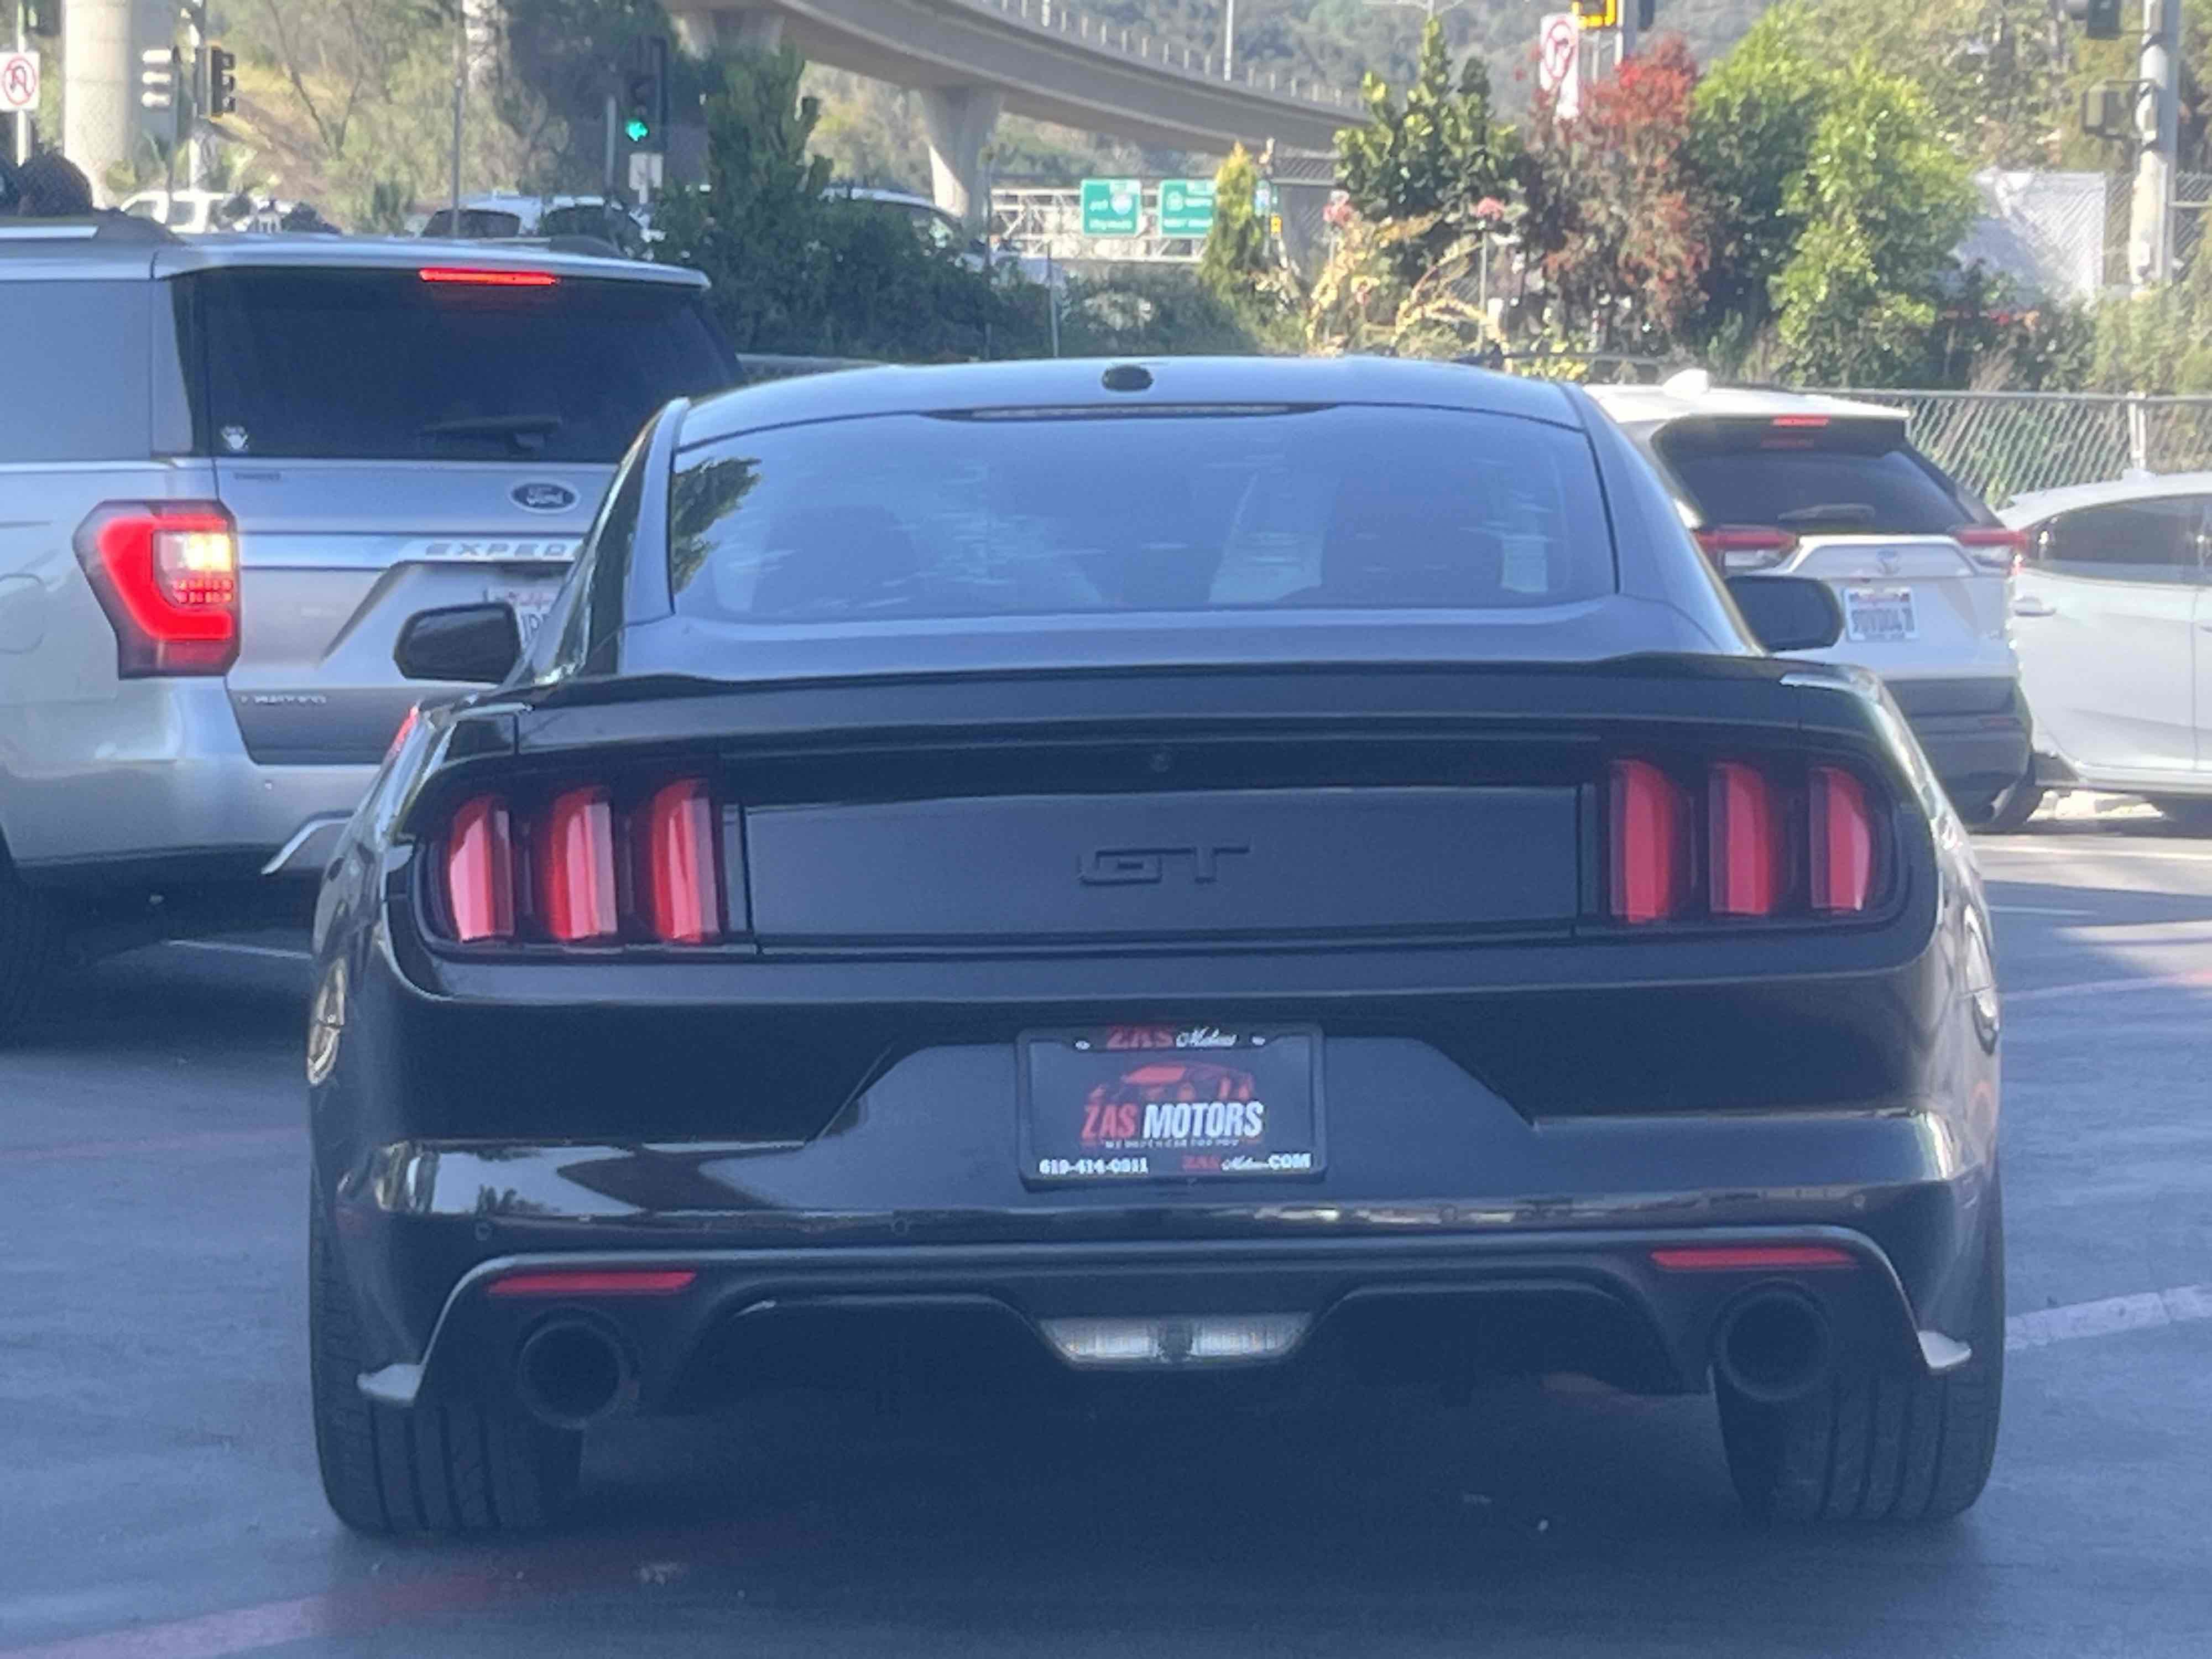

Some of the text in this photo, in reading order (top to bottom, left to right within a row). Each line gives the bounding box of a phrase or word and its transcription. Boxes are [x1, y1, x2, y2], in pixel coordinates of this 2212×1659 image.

[1078, 846, 1251, 886] GT
[1081, 1100, 1264, 1139] ZAS MOTORS
